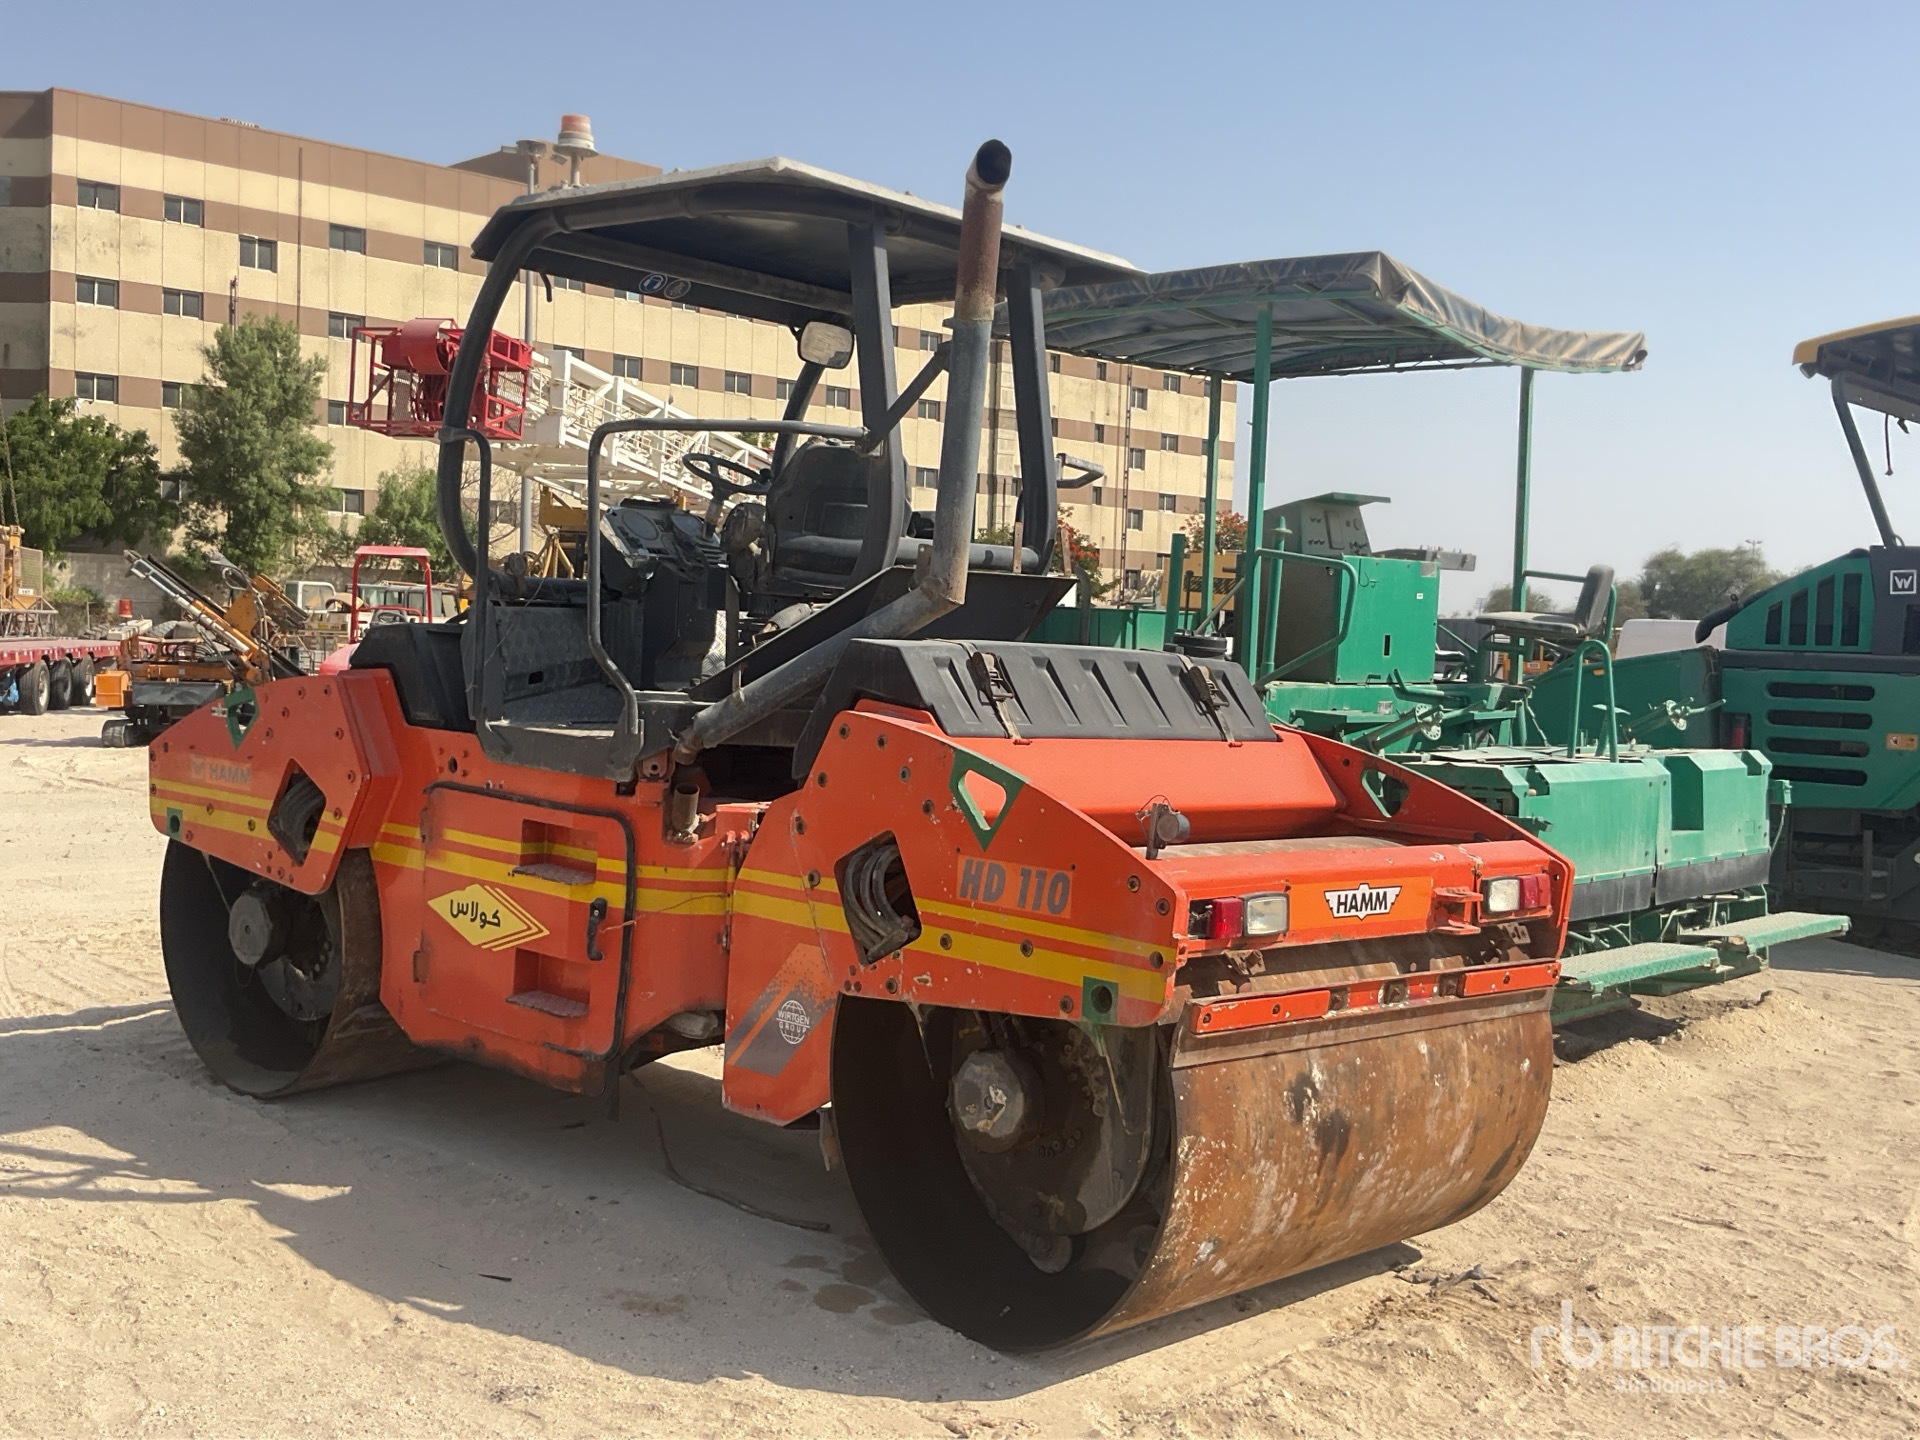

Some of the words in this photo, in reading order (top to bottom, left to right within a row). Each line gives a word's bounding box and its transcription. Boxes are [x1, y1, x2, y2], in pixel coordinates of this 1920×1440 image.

[959, 858, 1006, 903] HD
[1017, 867, 1070, 915] 110
[450, 899, 501, 929] كولاس
[1337, 891, 1388, 914] HAMM
[778, 1009, 810, 1025] WIRTGEN
[778, 1021, 807, 1033] GROUP
